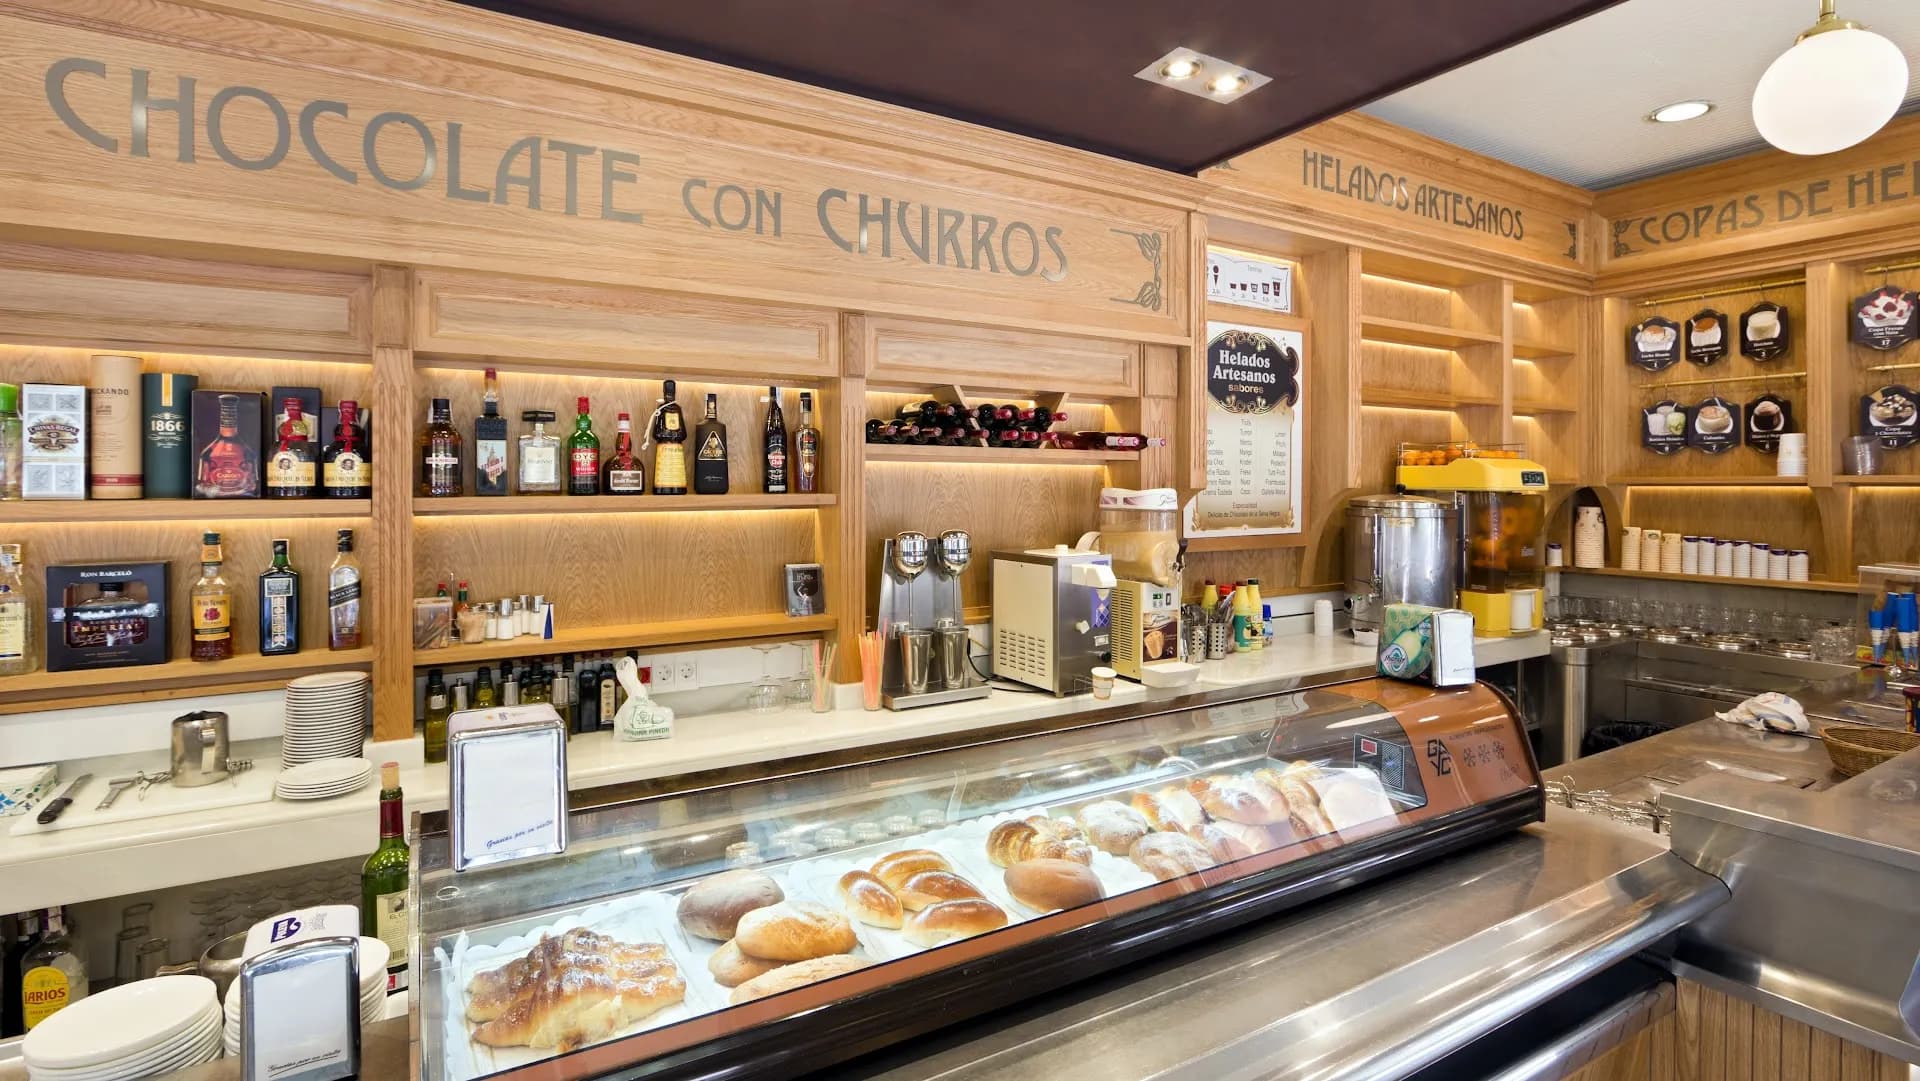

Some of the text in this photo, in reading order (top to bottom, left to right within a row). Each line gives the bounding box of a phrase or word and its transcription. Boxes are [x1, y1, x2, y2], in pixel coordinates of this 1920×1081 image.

[45, 57, 1069, 283] CHOCOLATE CON CHURROS
[1303, 148, 1525, 241] HELADOS ARTESANOS
[1639, 194, 1765, 245] COPAS
[1778, 179, 1834, 222] DE
[1219, 349, 1271, 369] Helados
[1212, 364, 1277, 384] Artesanos
[1228, 382, 1264, 394] sabores
[151, 420, 185, 432] 1866
[72, 622, 141, 633] IMPERIAL
[486, 835, 513, 850] Gracias
